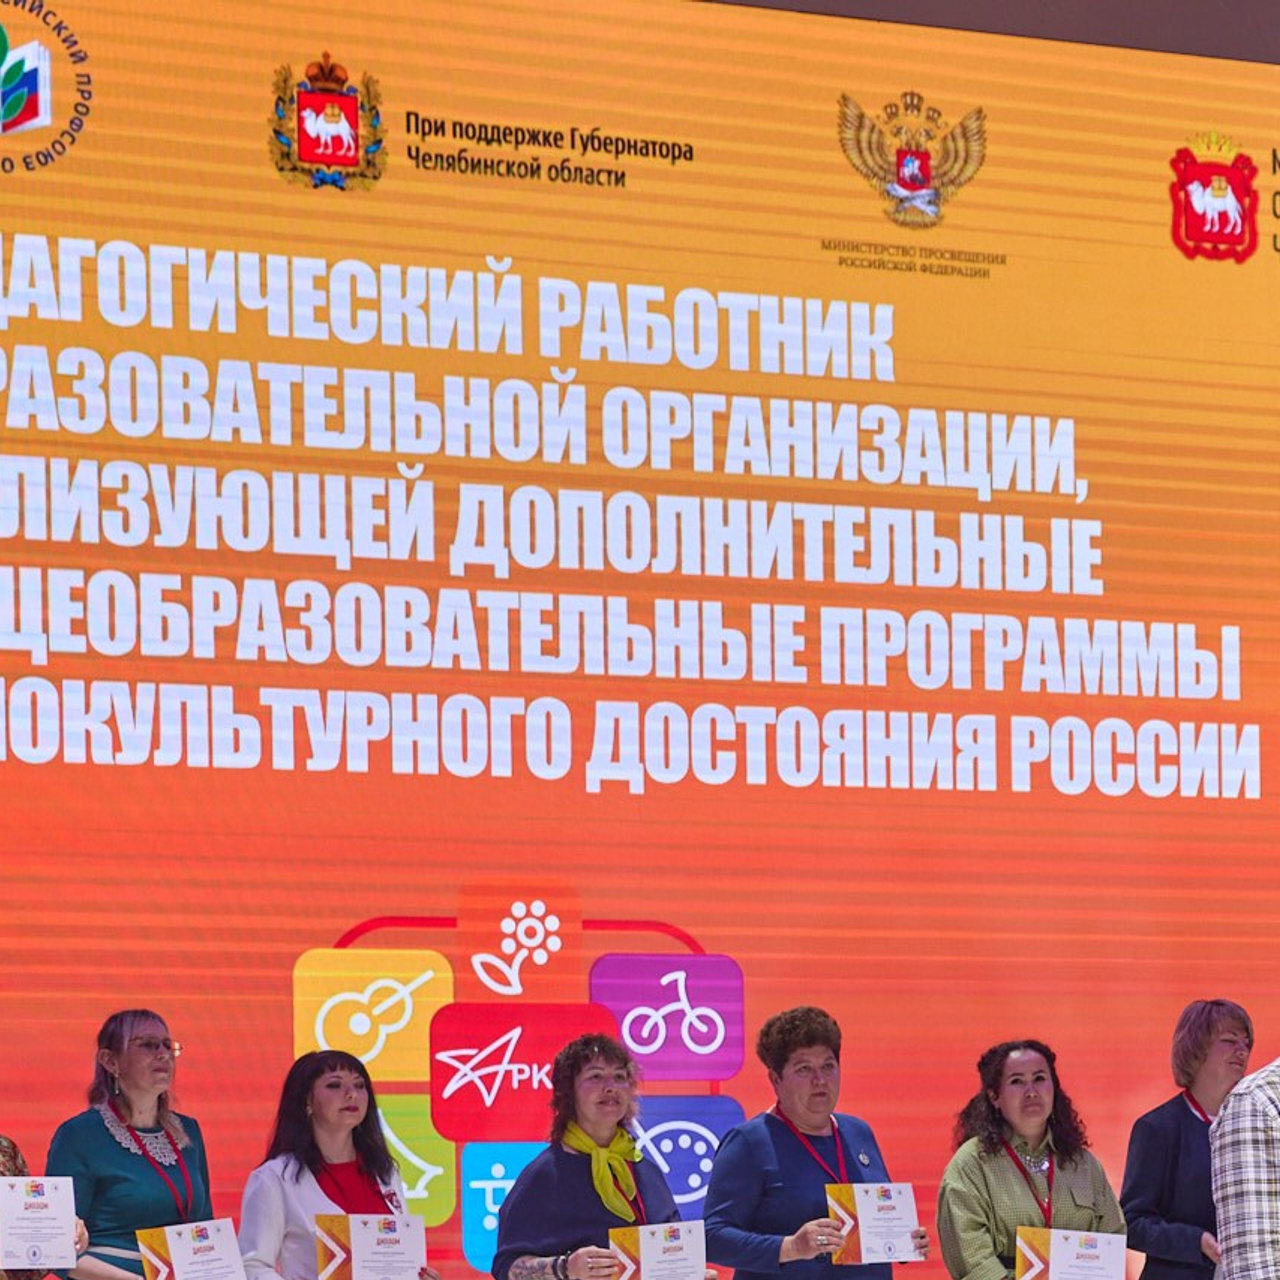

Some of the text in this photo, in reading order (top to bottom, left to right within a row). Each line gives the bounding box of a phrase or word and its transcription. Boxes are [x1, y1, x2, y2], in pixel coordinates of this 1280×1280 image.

[405, 111, 694, 165] При поддержке Губернатора
[407, 146, 626, 187] Челябинской области
[821, 239, 1007, 265] МИНИСТЕРСТВО ПРОСВЕЩЕНИЯ
[838, 256, 991, 279] РОССИЙСКОЙ ФЕДЕРАЦИИ
[0, 232, 896, 383] АГОГИЧЕСКИЙ РАБОТНИК
[0, 344, 1088, 504] АЗОВАТЕЛЬНОЙ ОРГАНИЗАЦИИ,
[449, 485, 1104, 596] ДОПОЛНИТЕЛЬНЫЕ
[820, 606, 1241, 701] ПРОГРАММЫ
[0, 675, 1261, 800] ОКУЛЬТУРНОГО ДОСТОЯНИЯ РОССИИ
